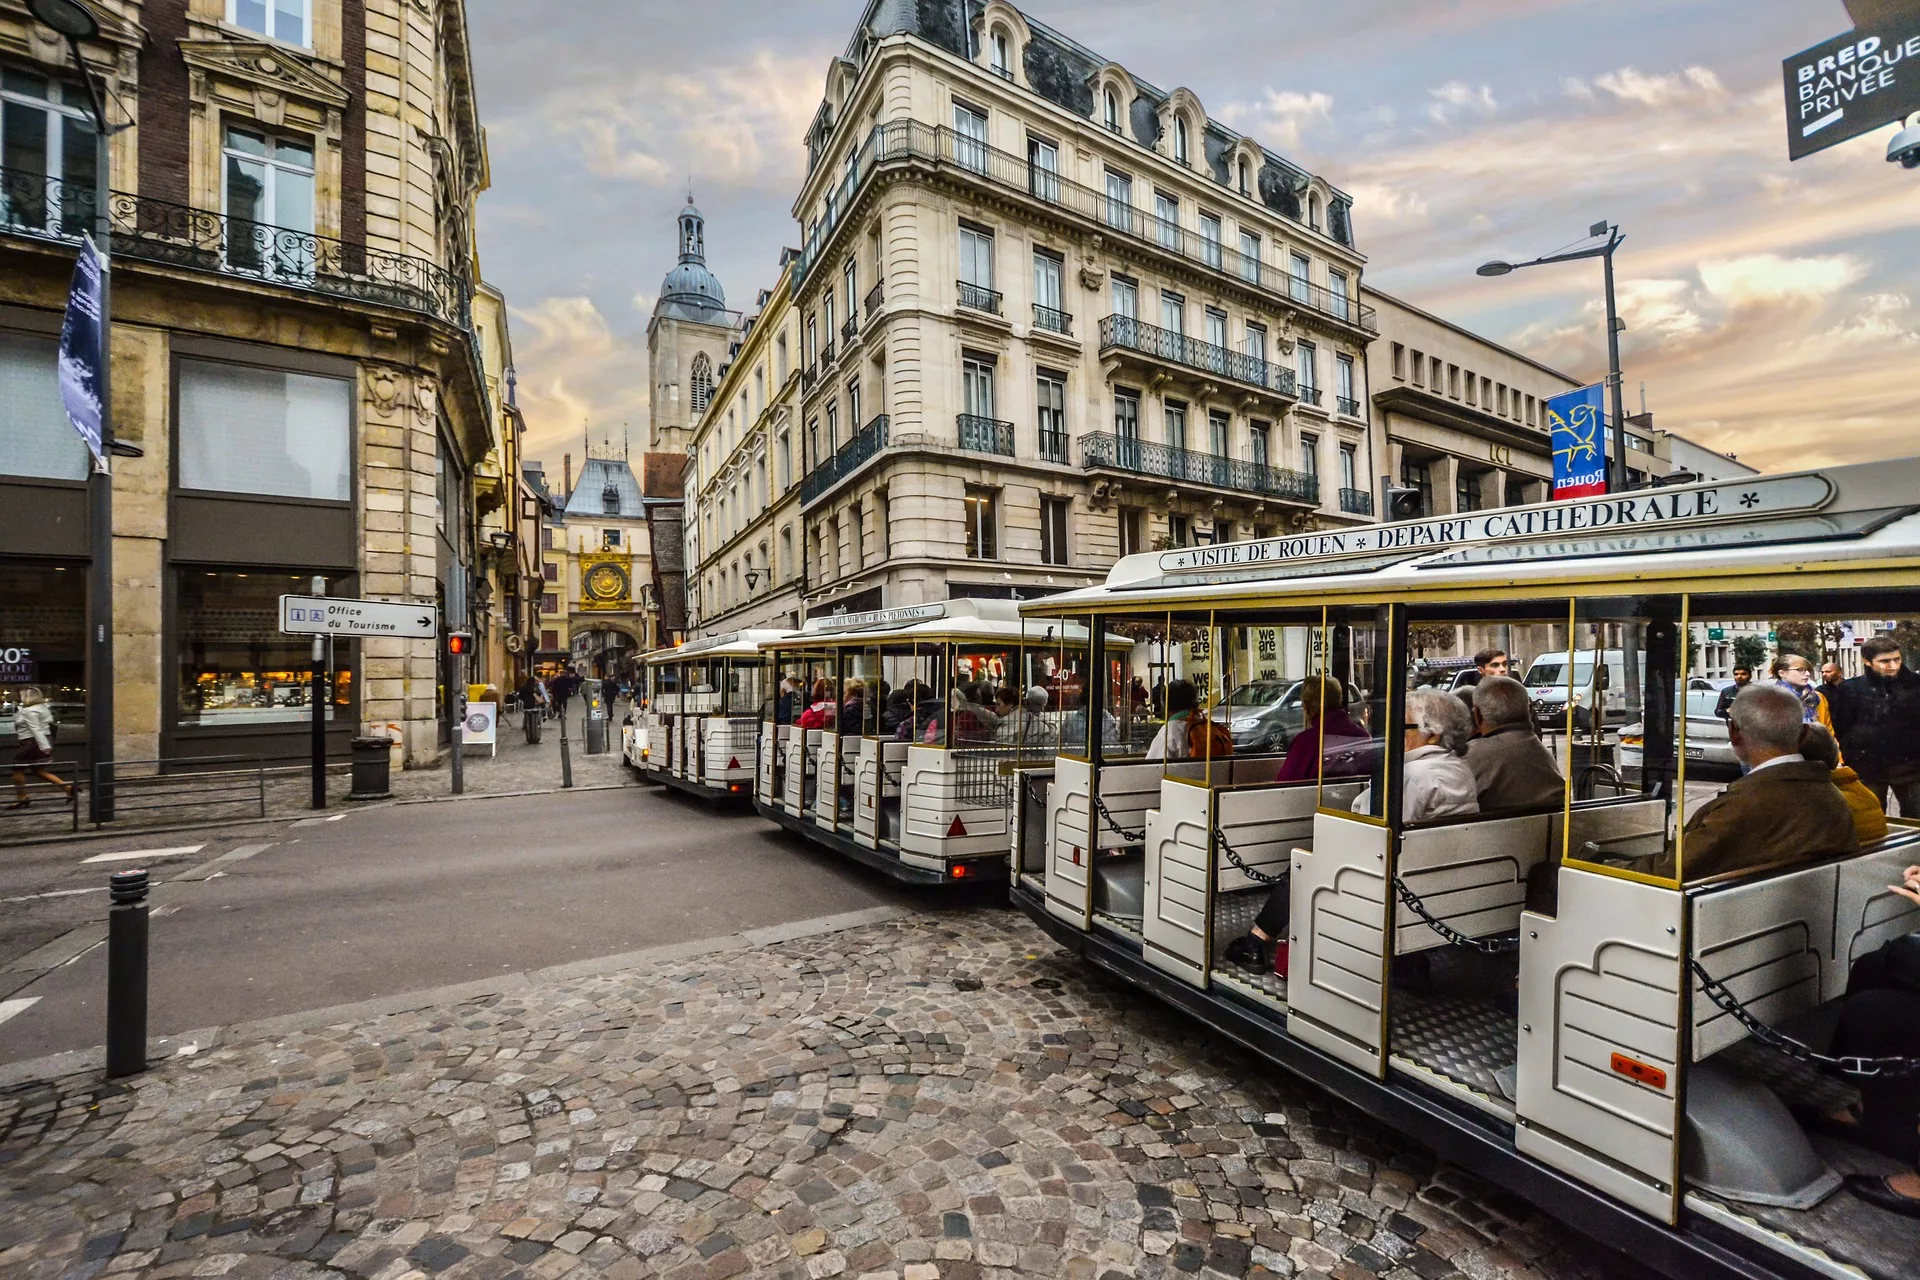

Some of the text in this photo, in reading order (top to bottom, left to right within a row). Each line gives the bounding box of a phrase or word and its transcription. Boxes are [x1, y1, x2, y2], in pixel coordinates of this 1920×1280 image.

[1798, 36, 1881, 83] BRED
[1799, 35, 1920, 102] BANQUE
[1800, 67, 1896, 120] PRIVÉE
[1490, 444, 1513, 466] LCL
[1192, 546, 1241, 567] VISITE
[1248, 543, 1271, 561] DE
[1279, 534, 1347, 558] ROUEN
[1377, 519, 1472, 549] DEPART
[1484, 489, 1720, 537] CATHEDRALE
[328, 605, 363, 616] Office
[328, 619, 396, 631] du Tourisme
[1258, 629, 1275, 640] we
[1190, 641, 1210, 653] are
[1258, 640, 1276, 651] are
[1192, 672, 1210, 684] we
[1260, 669, 1277, 680] we
